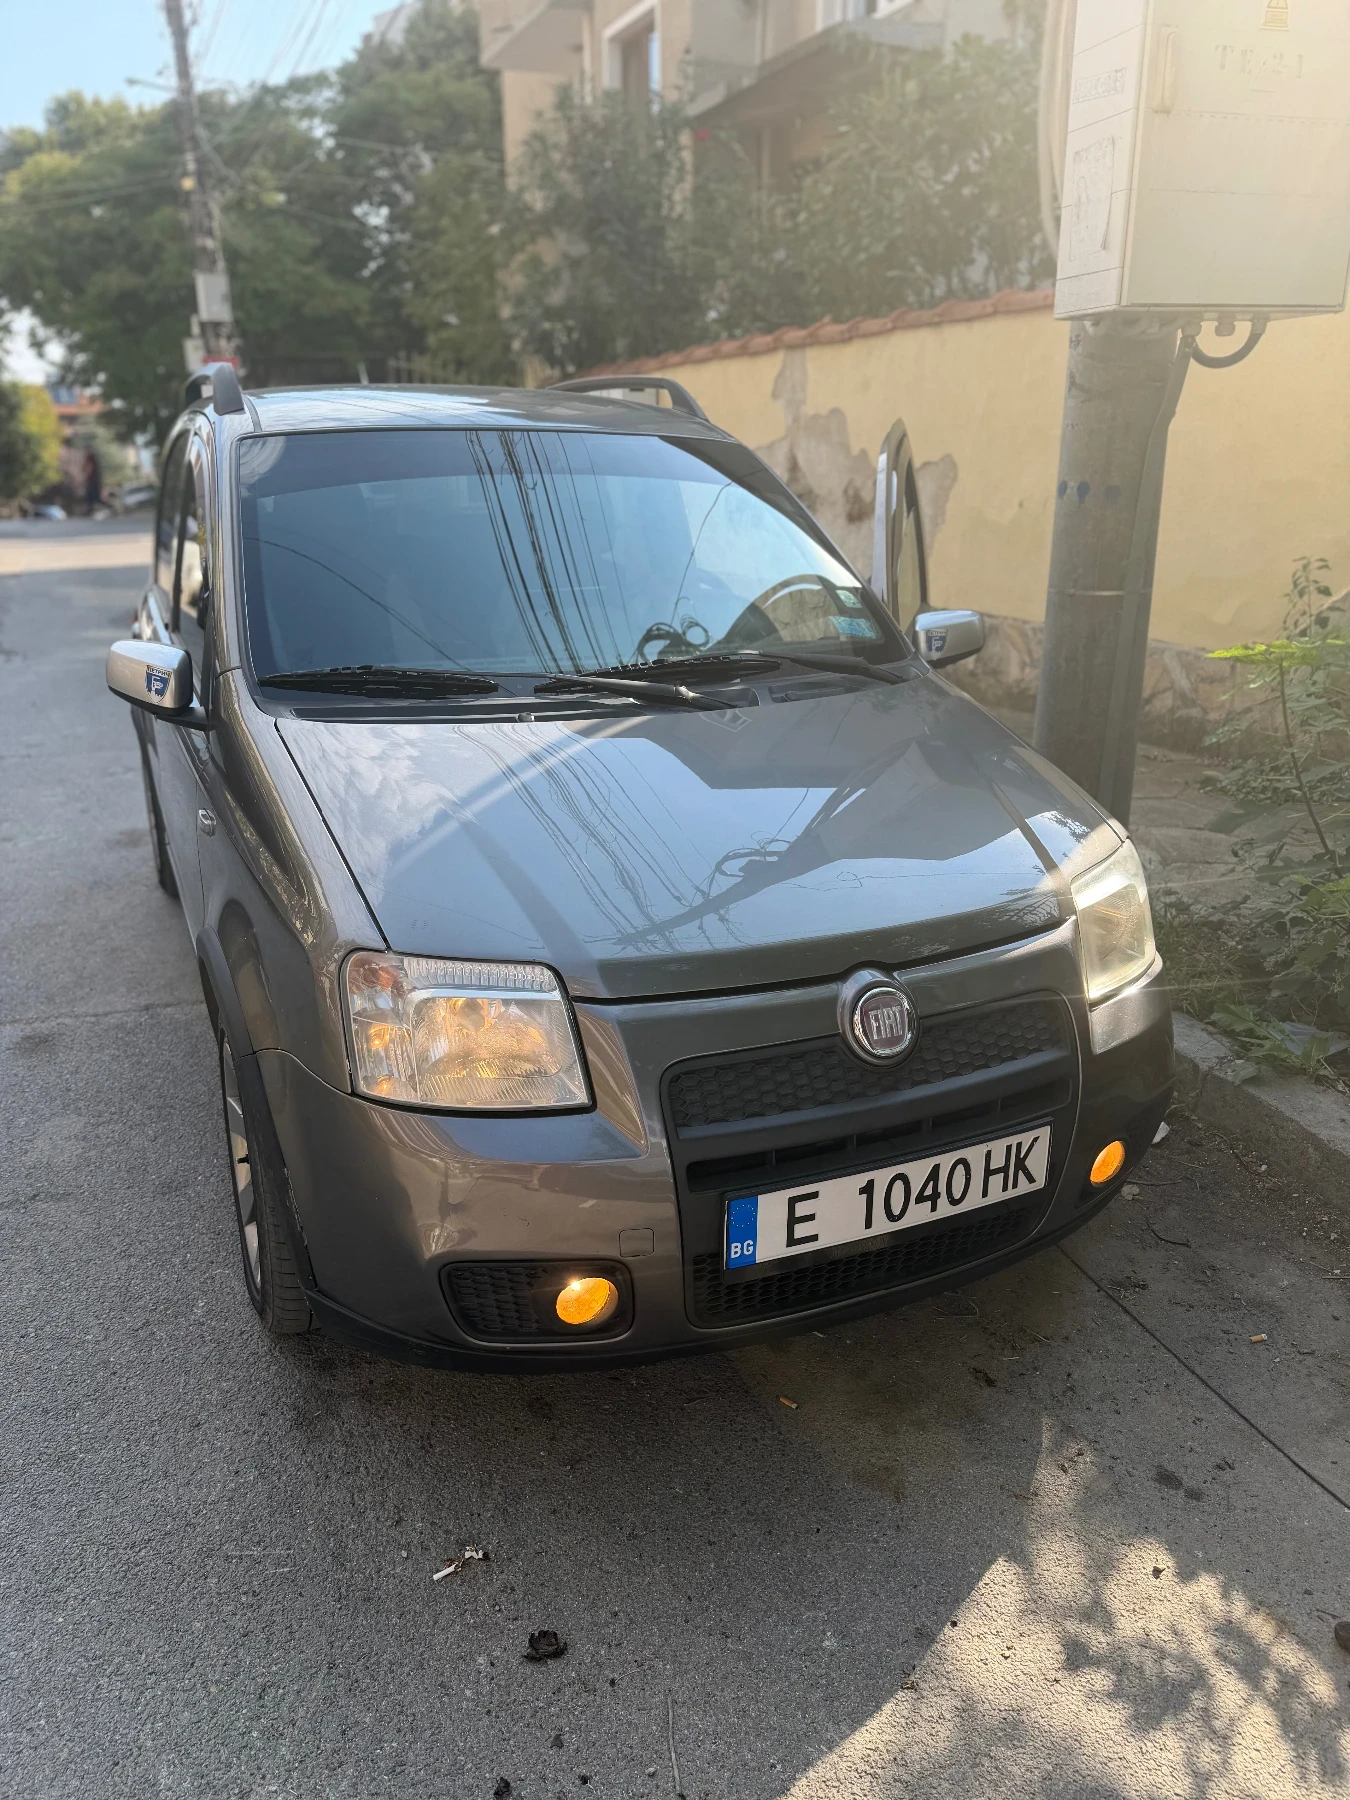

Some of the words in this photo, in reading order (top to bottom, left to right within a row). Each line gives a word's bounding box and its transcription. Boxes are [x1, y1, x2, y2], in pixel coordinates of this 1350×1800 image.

[868, 1005, 903, 1040] FIAT
[786, 1190, 820, 1249] E
[858, 1157, 972, 1230] 1040
[981, 1136, 1041, 1199] HK
[730, 1240, 754, 1259] BG
